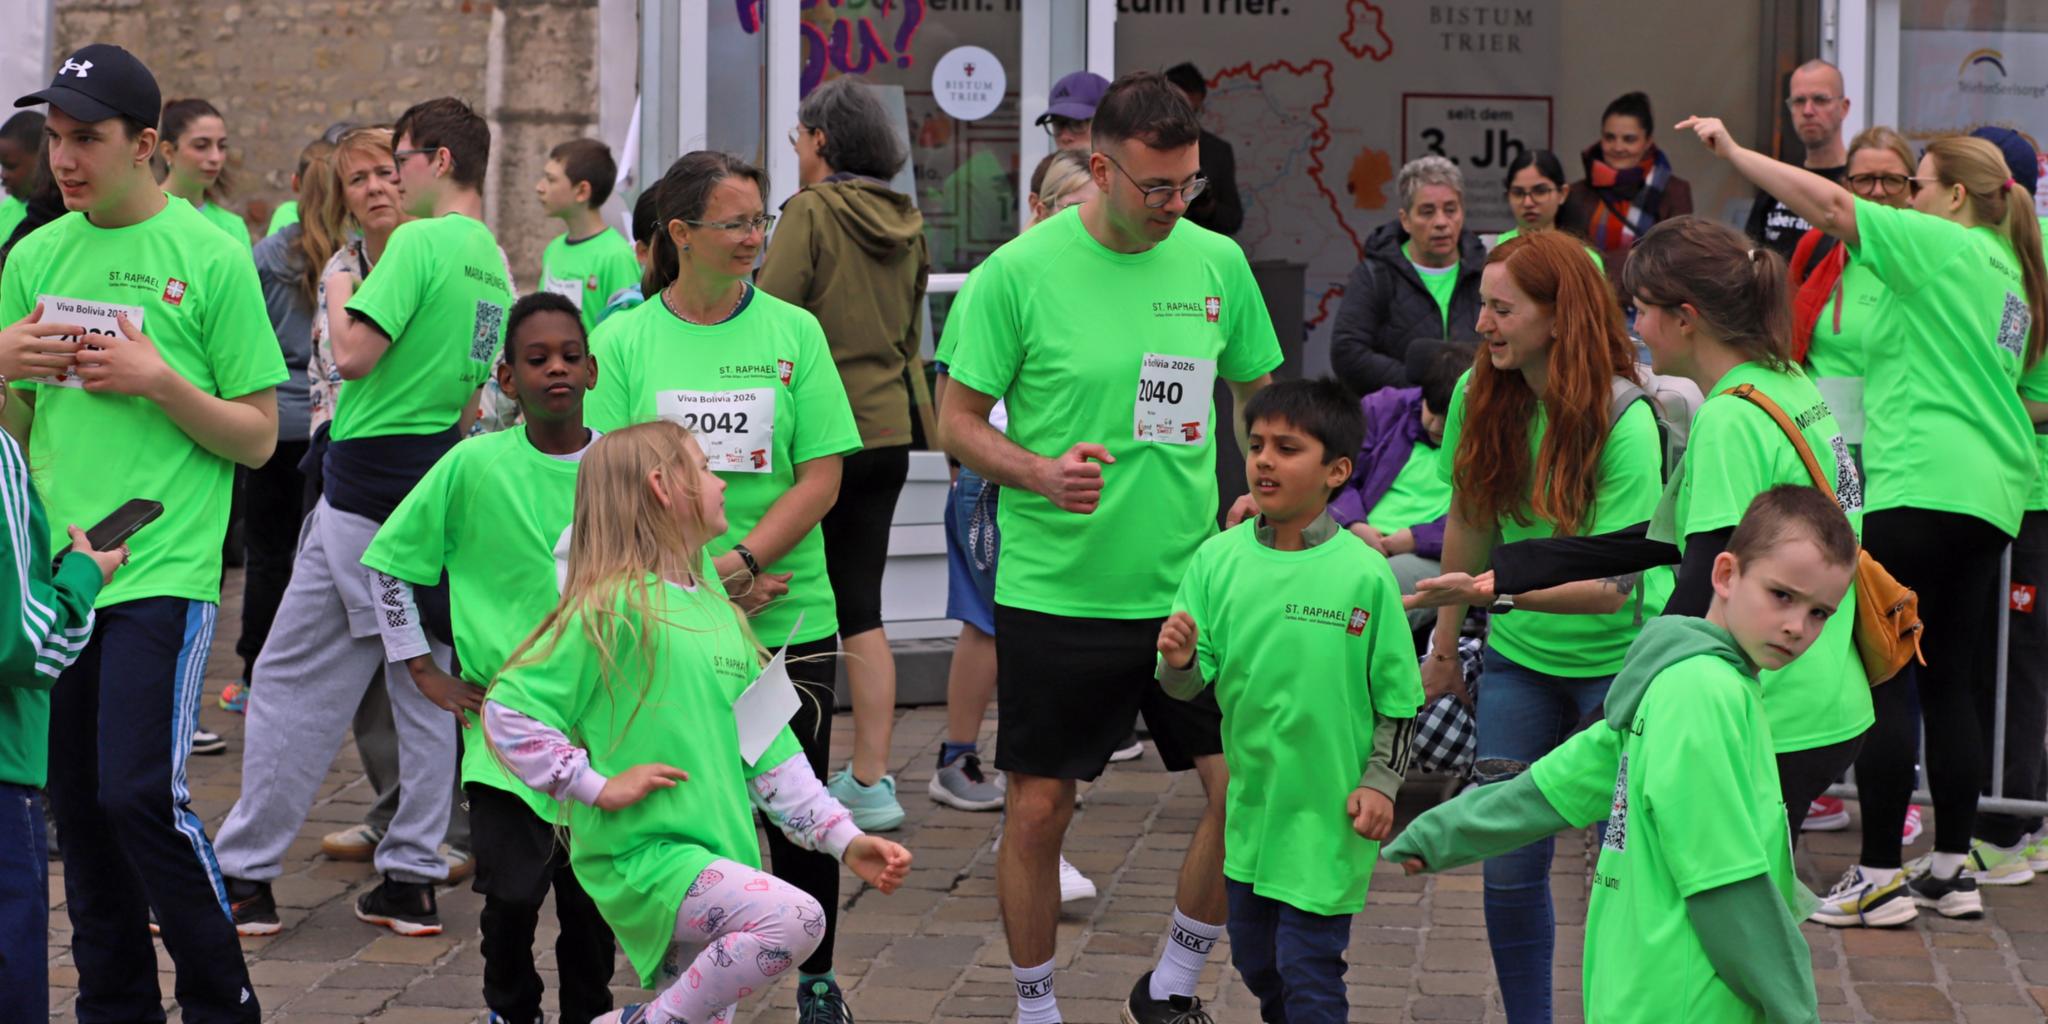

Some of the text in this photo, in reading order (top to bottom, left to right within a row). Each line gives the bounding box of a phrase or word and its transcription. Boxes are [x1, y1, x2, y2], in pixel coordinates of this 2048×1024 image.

[1430, 6, 1534, 27] BISTUM
[1441, 31, 1522, 52] TRIER
[945, 81, 993, 90] BISTUM
[950, 92, 988, 101] TRIER
[1446, 106, 1514, 121] seit dem
[1420, 127, 1460, 166] 3.
[109, 271, 122, 281] ST.
[124, 272, 160, 289] RAPHAEL
[56, 302, 75, 312] Viva
[76, 304, 106, 318] Bolivia
[1152, 302, 1203, 312] ST. RAPHAEL
[719, 364, 777, 374] ST. RAPHAEL
[1171, 361, 1195, 372] 2026
[677, 392, 756, 403] Viva Bolivia 2026
[1138, 378, 1183, 404] 2040
[684, 412, 749, 434] 2042
[1285, 604, 1300, 614] ST.
[1302, 605, 1347, 622] RAPHAEL
